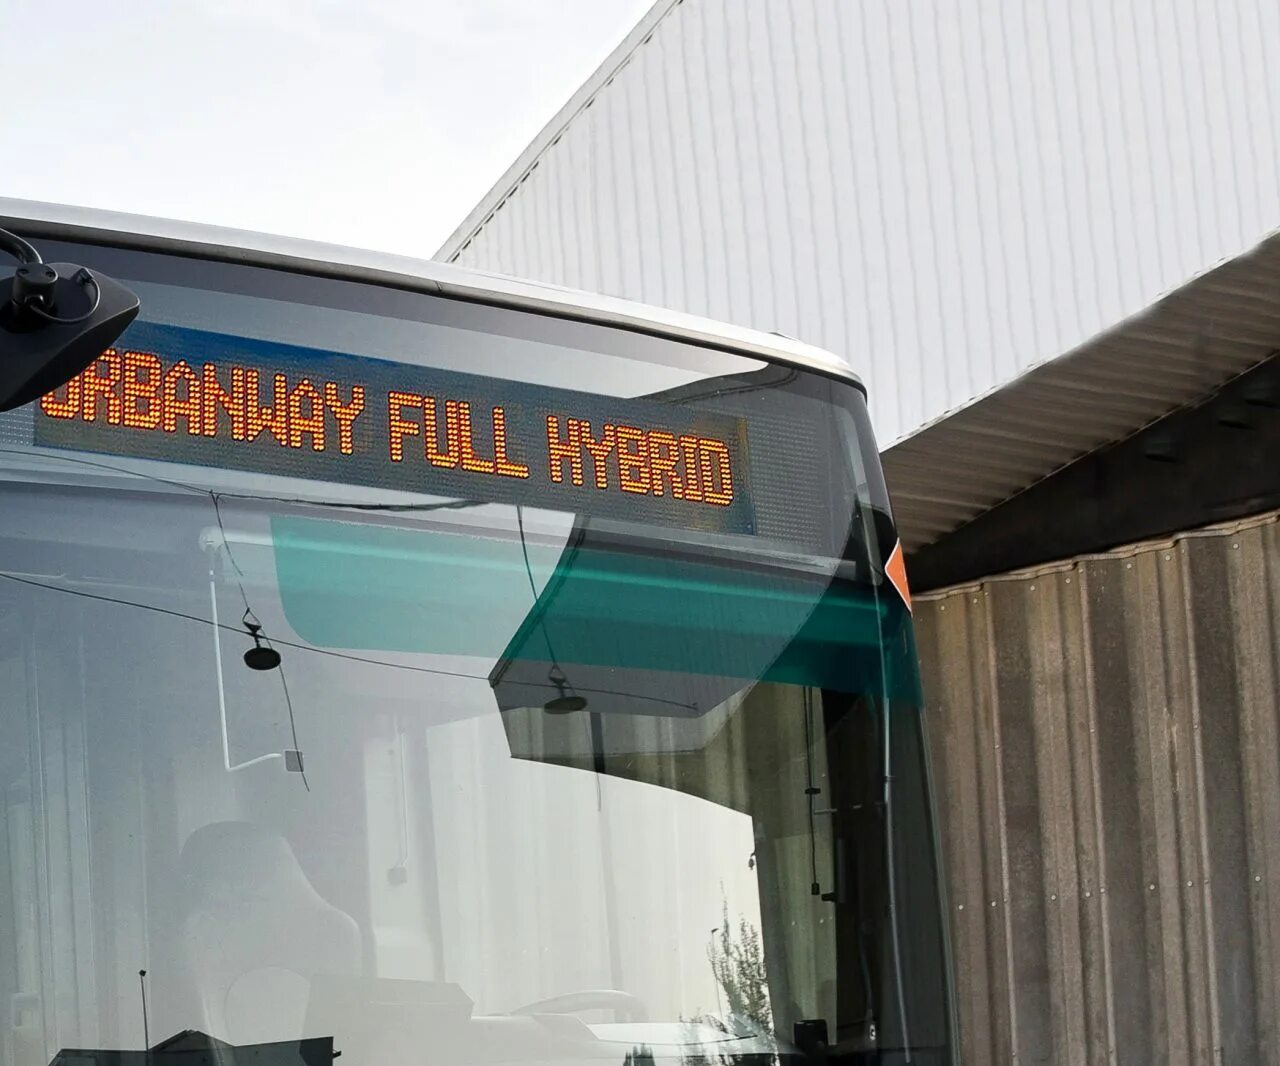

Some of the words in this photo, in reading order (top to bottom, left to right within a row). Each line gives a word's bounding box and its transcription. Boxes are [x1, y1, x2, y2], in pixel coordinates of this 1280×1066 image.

[40, 348, 365, 456] URBANWAY
[388, 390, 530, 479] FULL
[546, 414, 734, 506] HYBRID
